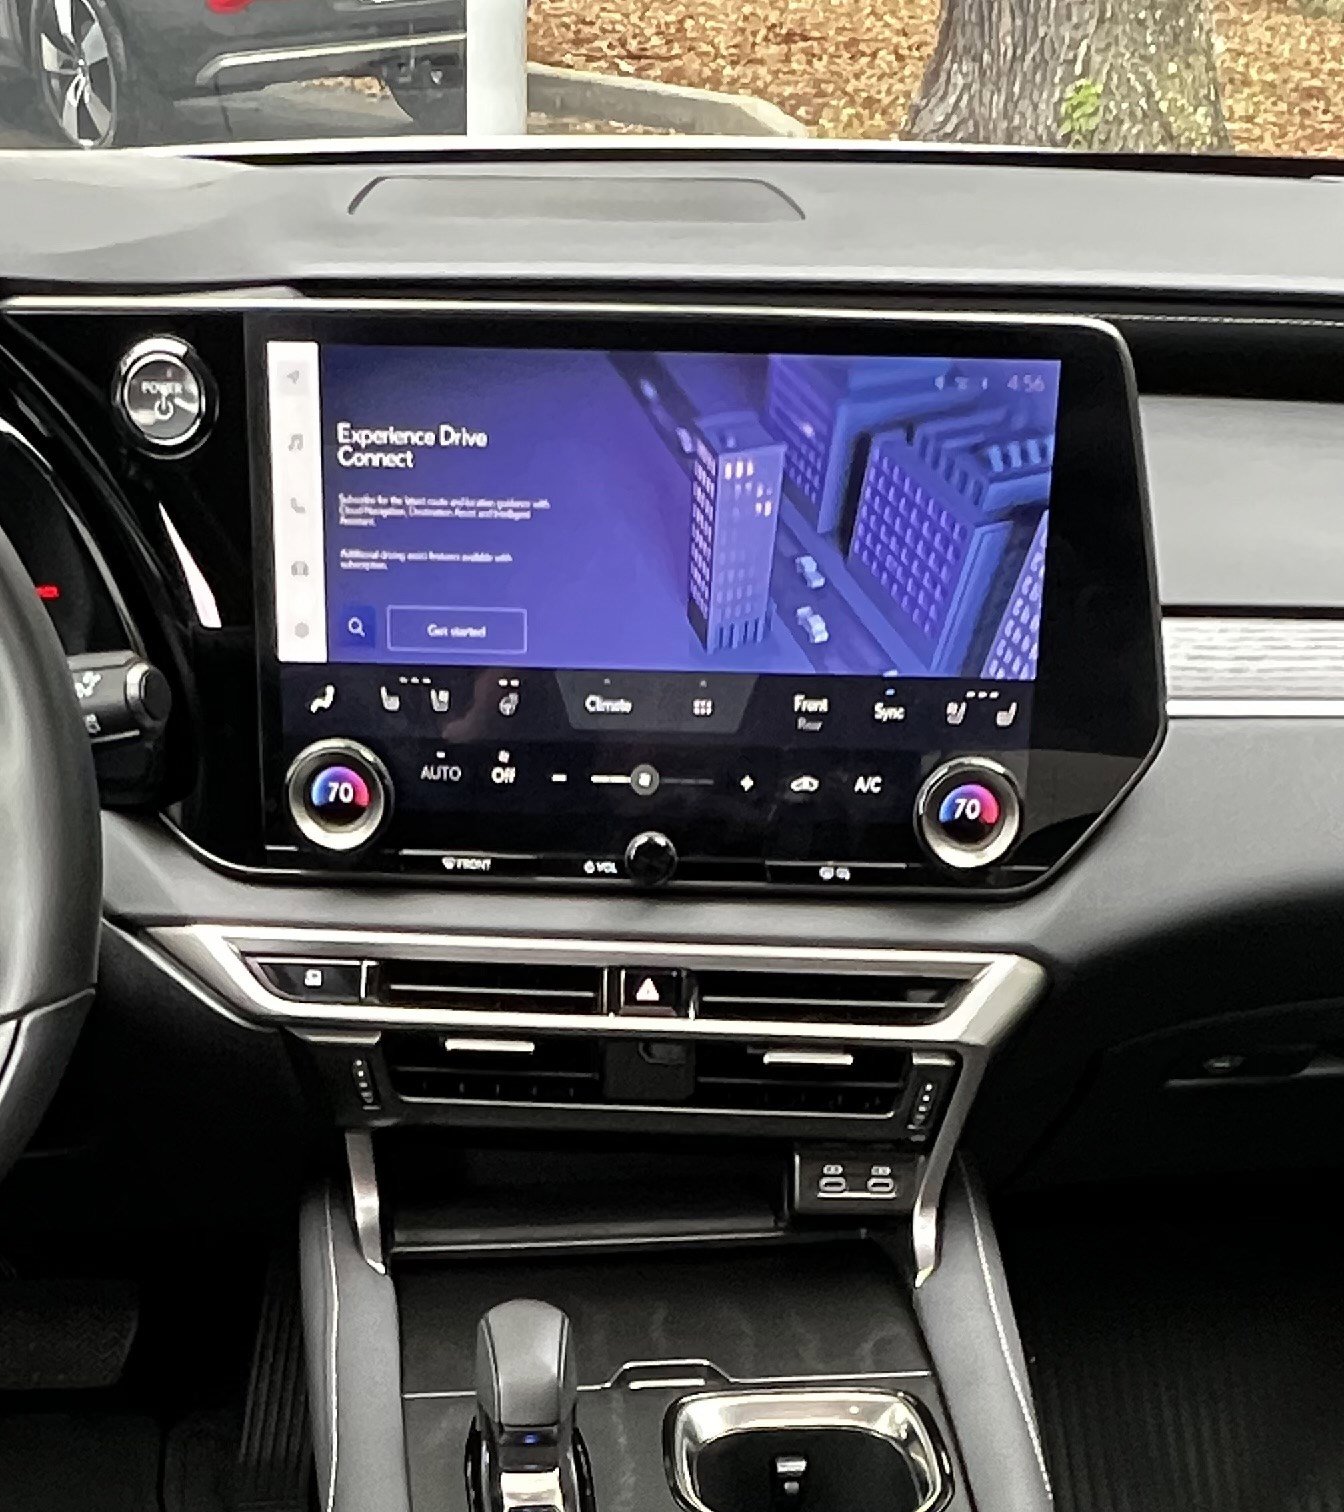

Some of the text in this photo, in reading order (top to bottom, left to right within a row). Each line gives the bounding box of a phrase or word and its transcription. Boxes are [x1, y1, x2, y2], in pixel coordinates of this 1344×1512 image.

[337, 422, 488, 448] Experience Drive
[337, 446, 414, 468] Connect
[427, 624, 486, 638] Get started
[584, 694, 632, 713] Climate
[793, 694, 829, 713] Front
[874, 702, 905, 722] Sync
[420, 765, 462, 782] AUTO
[491, 766, 516, 784] Off
[327, 782, 354, 804] 70
[854, 776, 882, 793] A/C
[954, 798, 981, 820] 70
